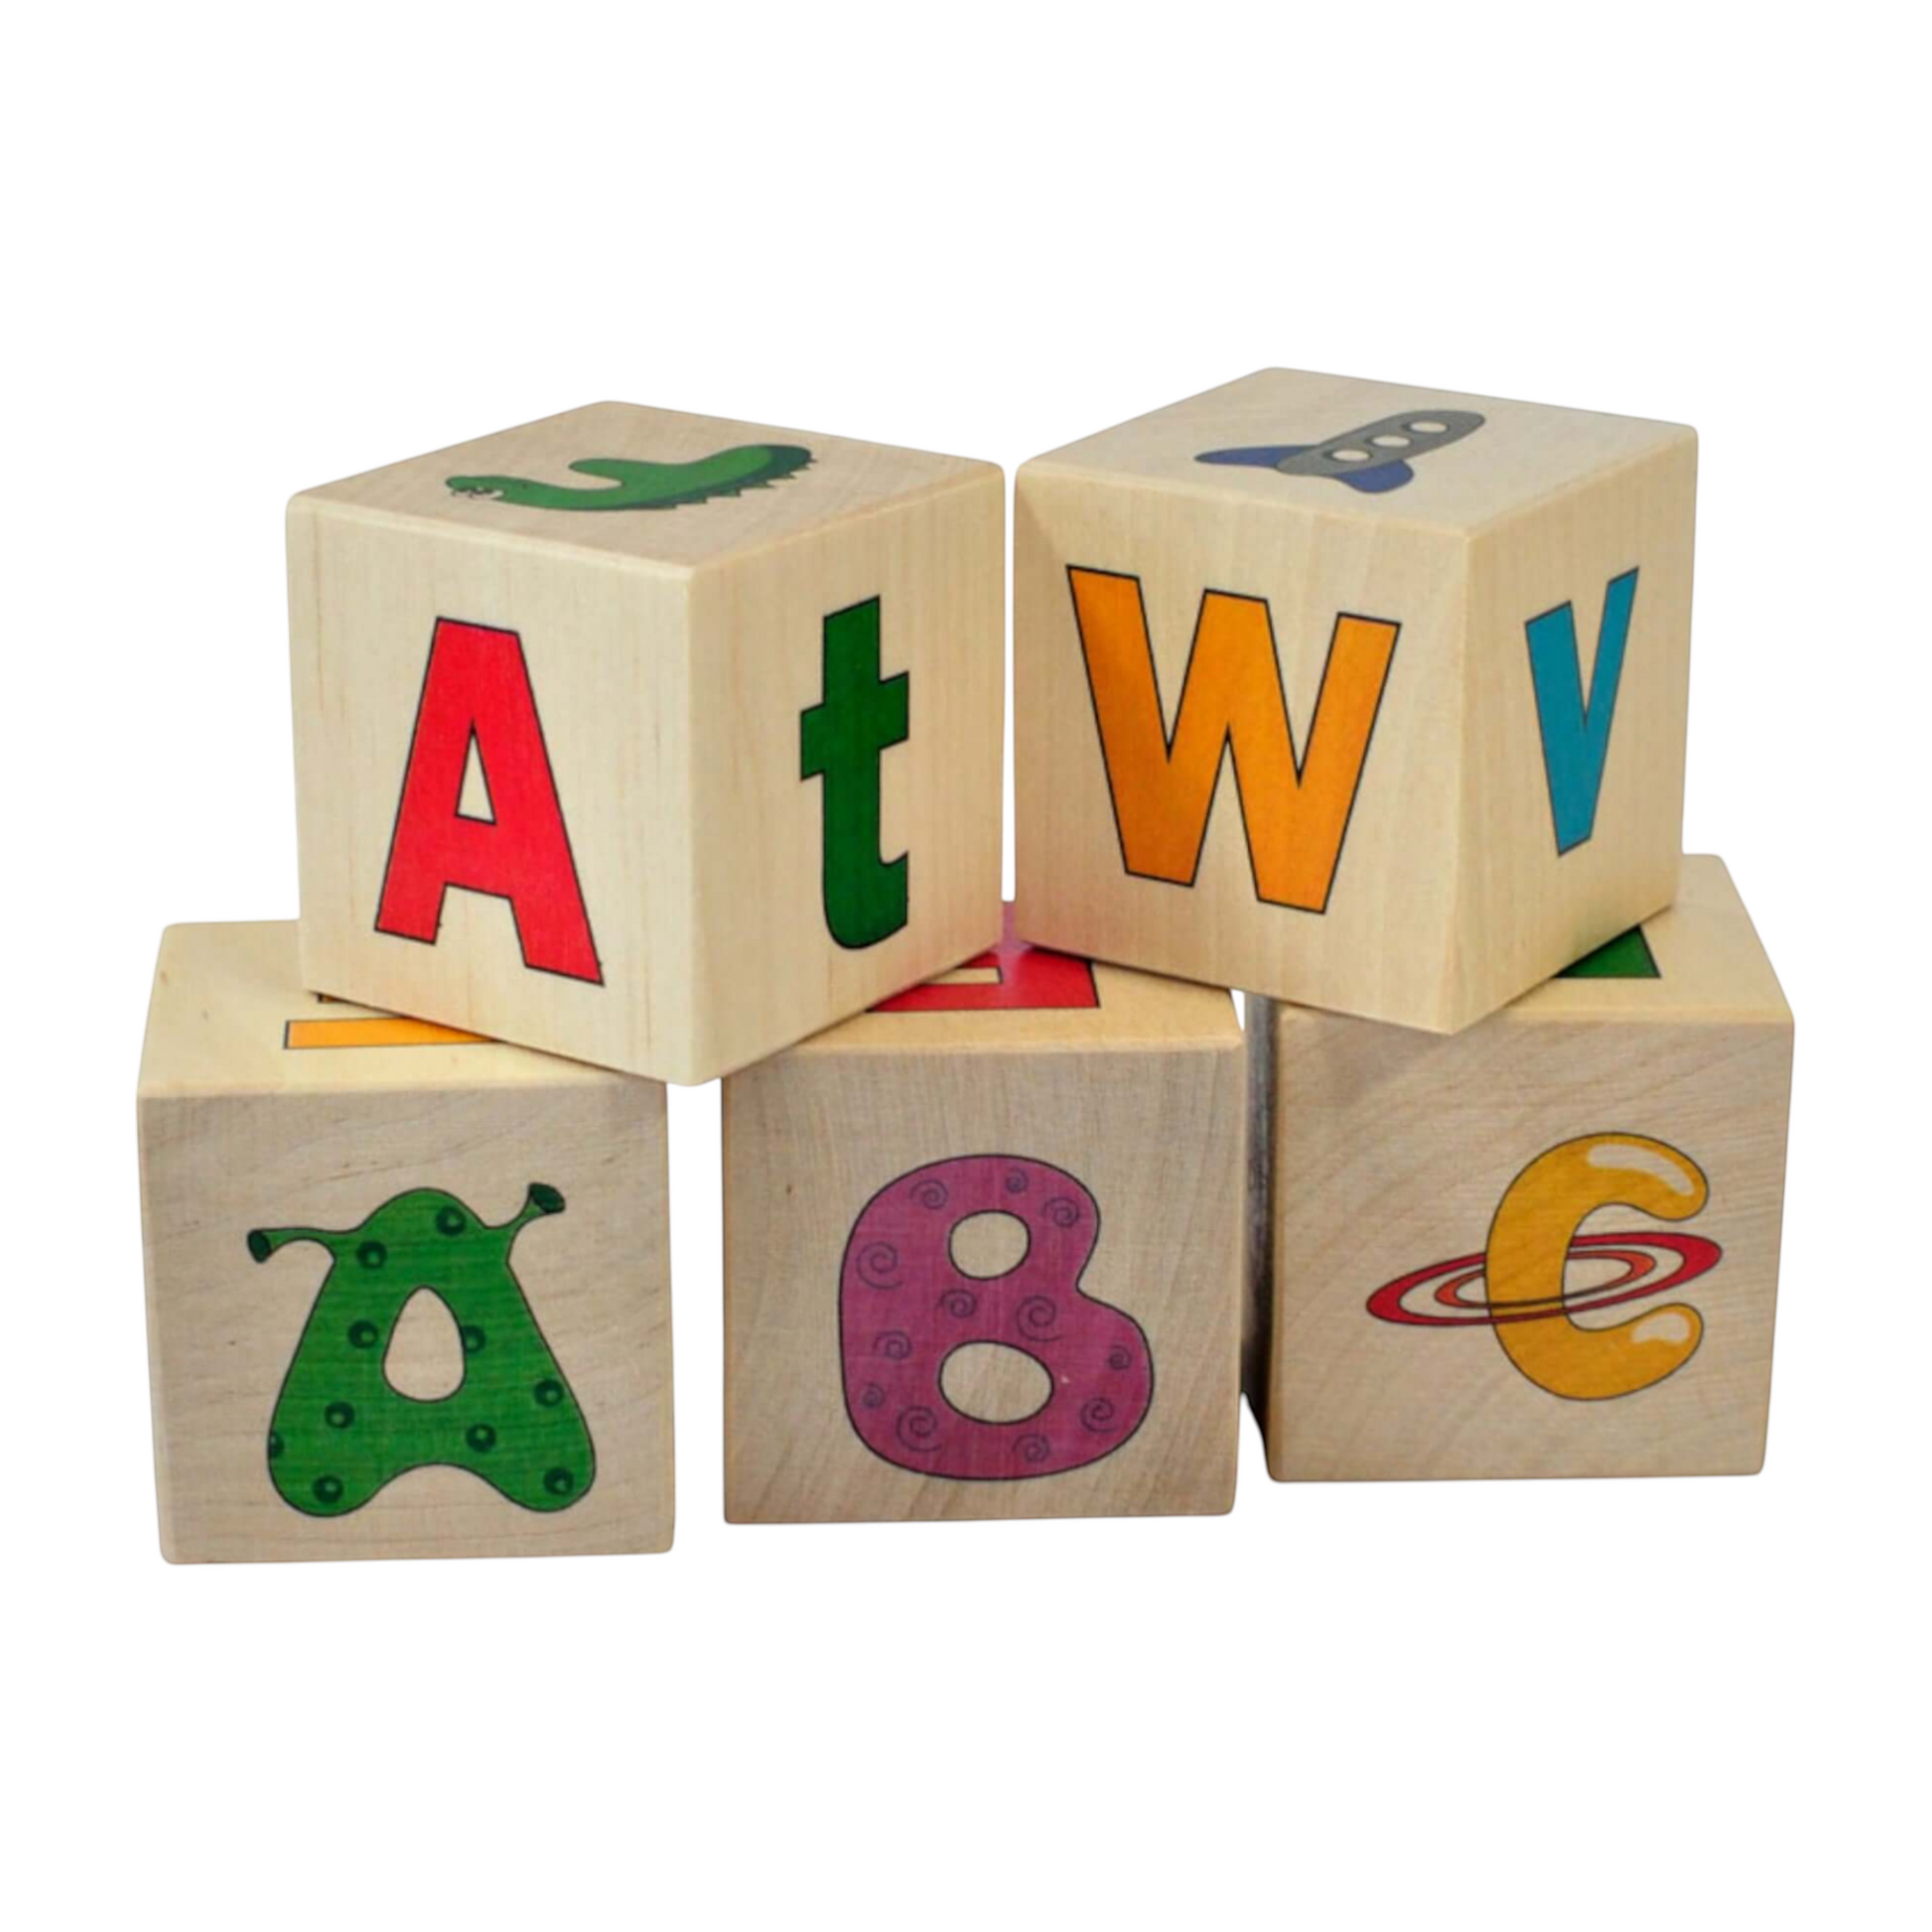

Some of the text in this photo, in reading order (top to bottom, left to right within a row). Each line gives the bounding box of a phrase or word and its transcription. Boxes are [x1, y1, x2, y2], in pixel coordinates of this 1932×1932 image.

[374, 617, 605, 987] A
[800, 595, 909, 950] t
[1065, 564, 1402, 914] W
[248, 1182, 596, 1519] A
[839, 1154, 1154, 1481] B
[1485, 1131, 1710, 1402] C
